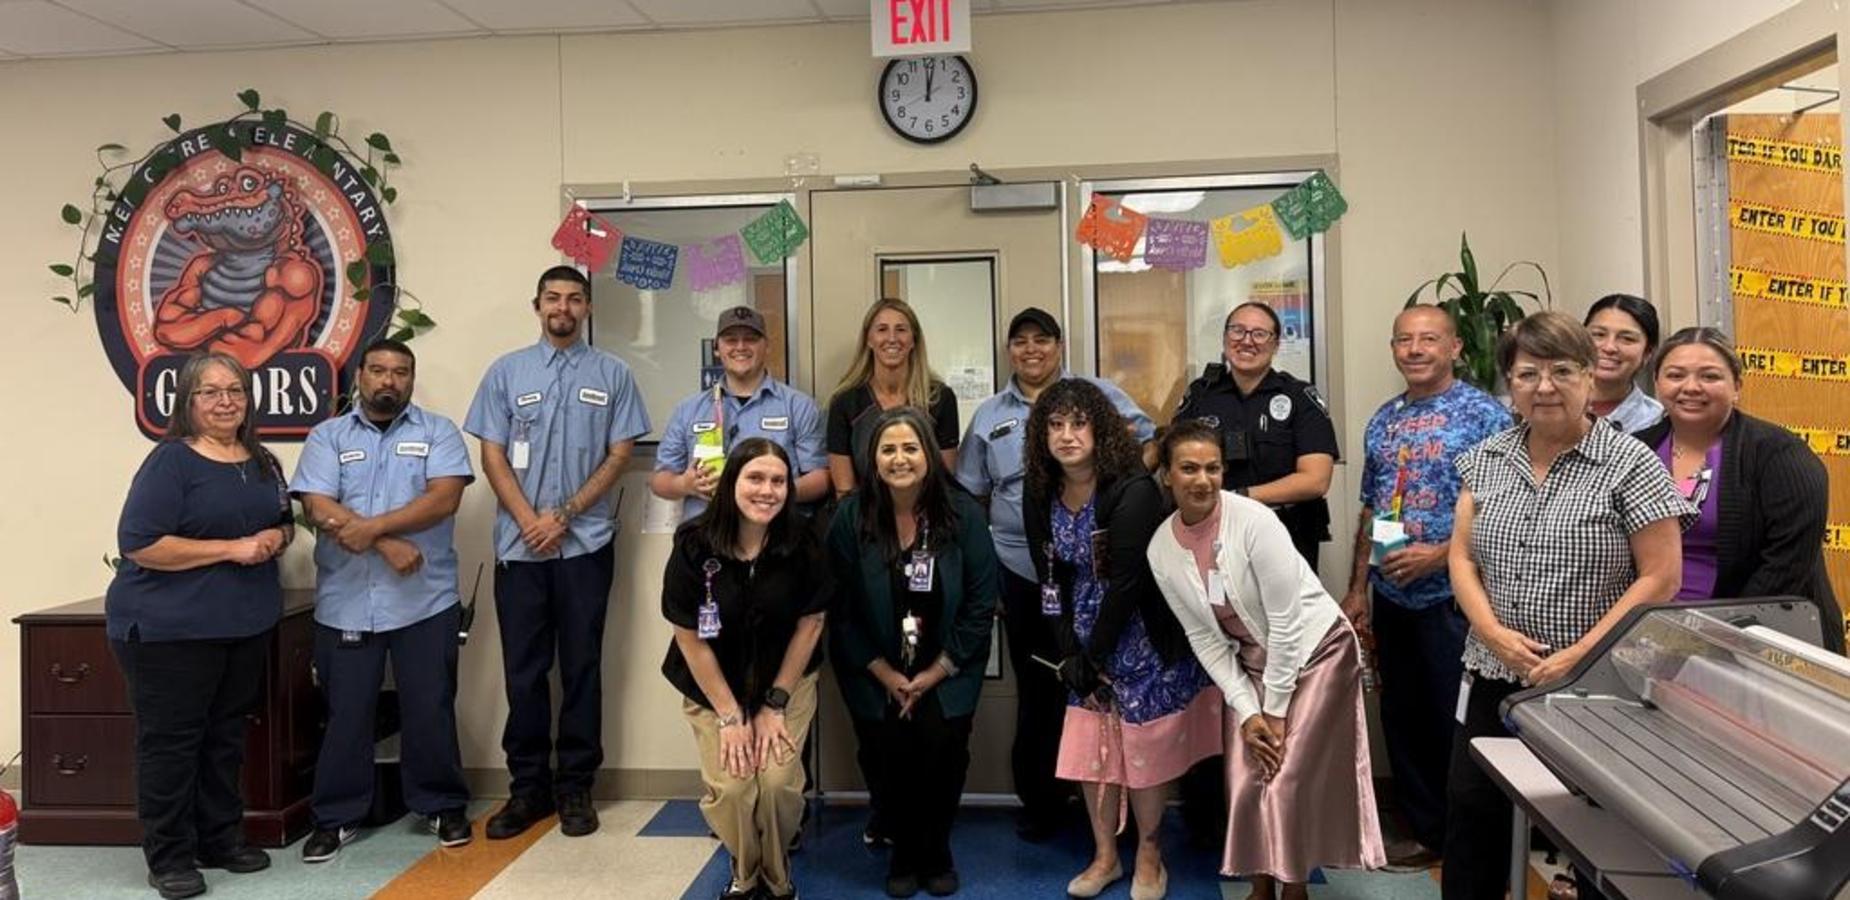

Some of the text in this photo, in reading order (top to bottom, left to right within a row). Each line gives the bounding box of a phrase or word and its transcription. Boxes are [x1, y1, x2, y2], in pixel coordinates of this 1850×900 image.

[890, 0, 950, 44] EXIT
[897, 72, 909, 86] 10
[951, 71, 961, 83] 2
[892, 89, 900, 102] 9
[957, 86, 966, 100] 3
[897, 106, 906, 118] 8
[951, 104, 960, 116] 4
[910, 116, 919, 129] 7
[924, 119, 933, 132] 6
[941, 115, 950, 128] 5
[1728, 139, 1756, 157] TER
[1781, 147, 1808, 163] YOU
[1813, 149, 1842, 169] DAR
[1740, 207, 1786, 229] ENTER
[1792, 216, 1806, 232] IF
[1811, 218, 1838, 236] YOU
[1768, 278, 1814, 299] ENTER
[1820, 285, 1834, 301] IF
[1802, 358, 1847, 376] ENTER
[155, 366, 318, 417] GORS
